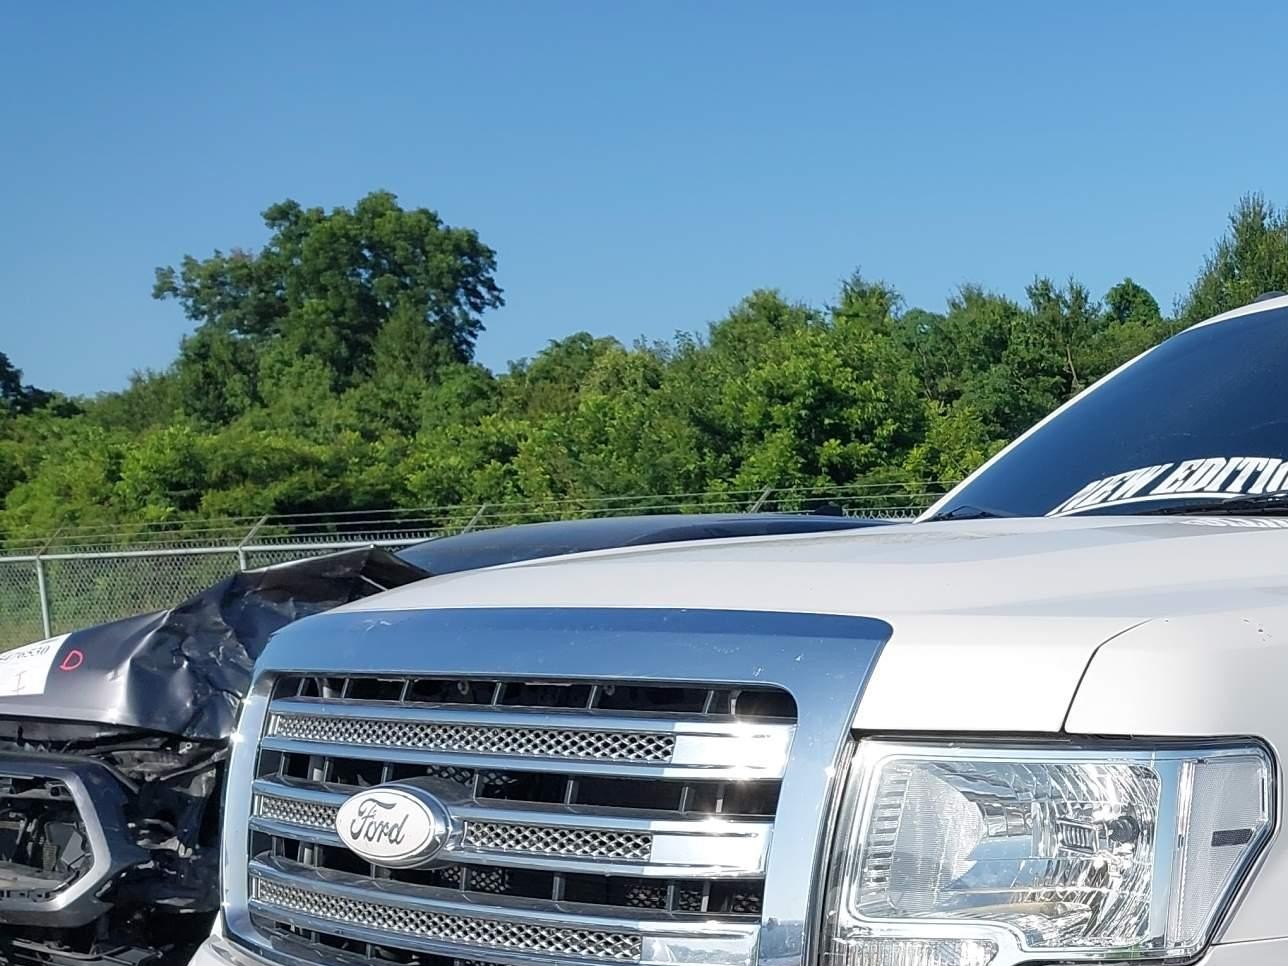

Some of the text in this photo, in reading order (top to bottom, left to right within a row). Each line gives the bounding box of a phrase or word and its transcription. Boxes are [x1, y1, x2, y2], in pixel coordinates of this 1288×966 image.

[1046, 463, 1174, 515] NEW
[60, 649, 84, 671] D
[350, 798, 409, 845] Ford
